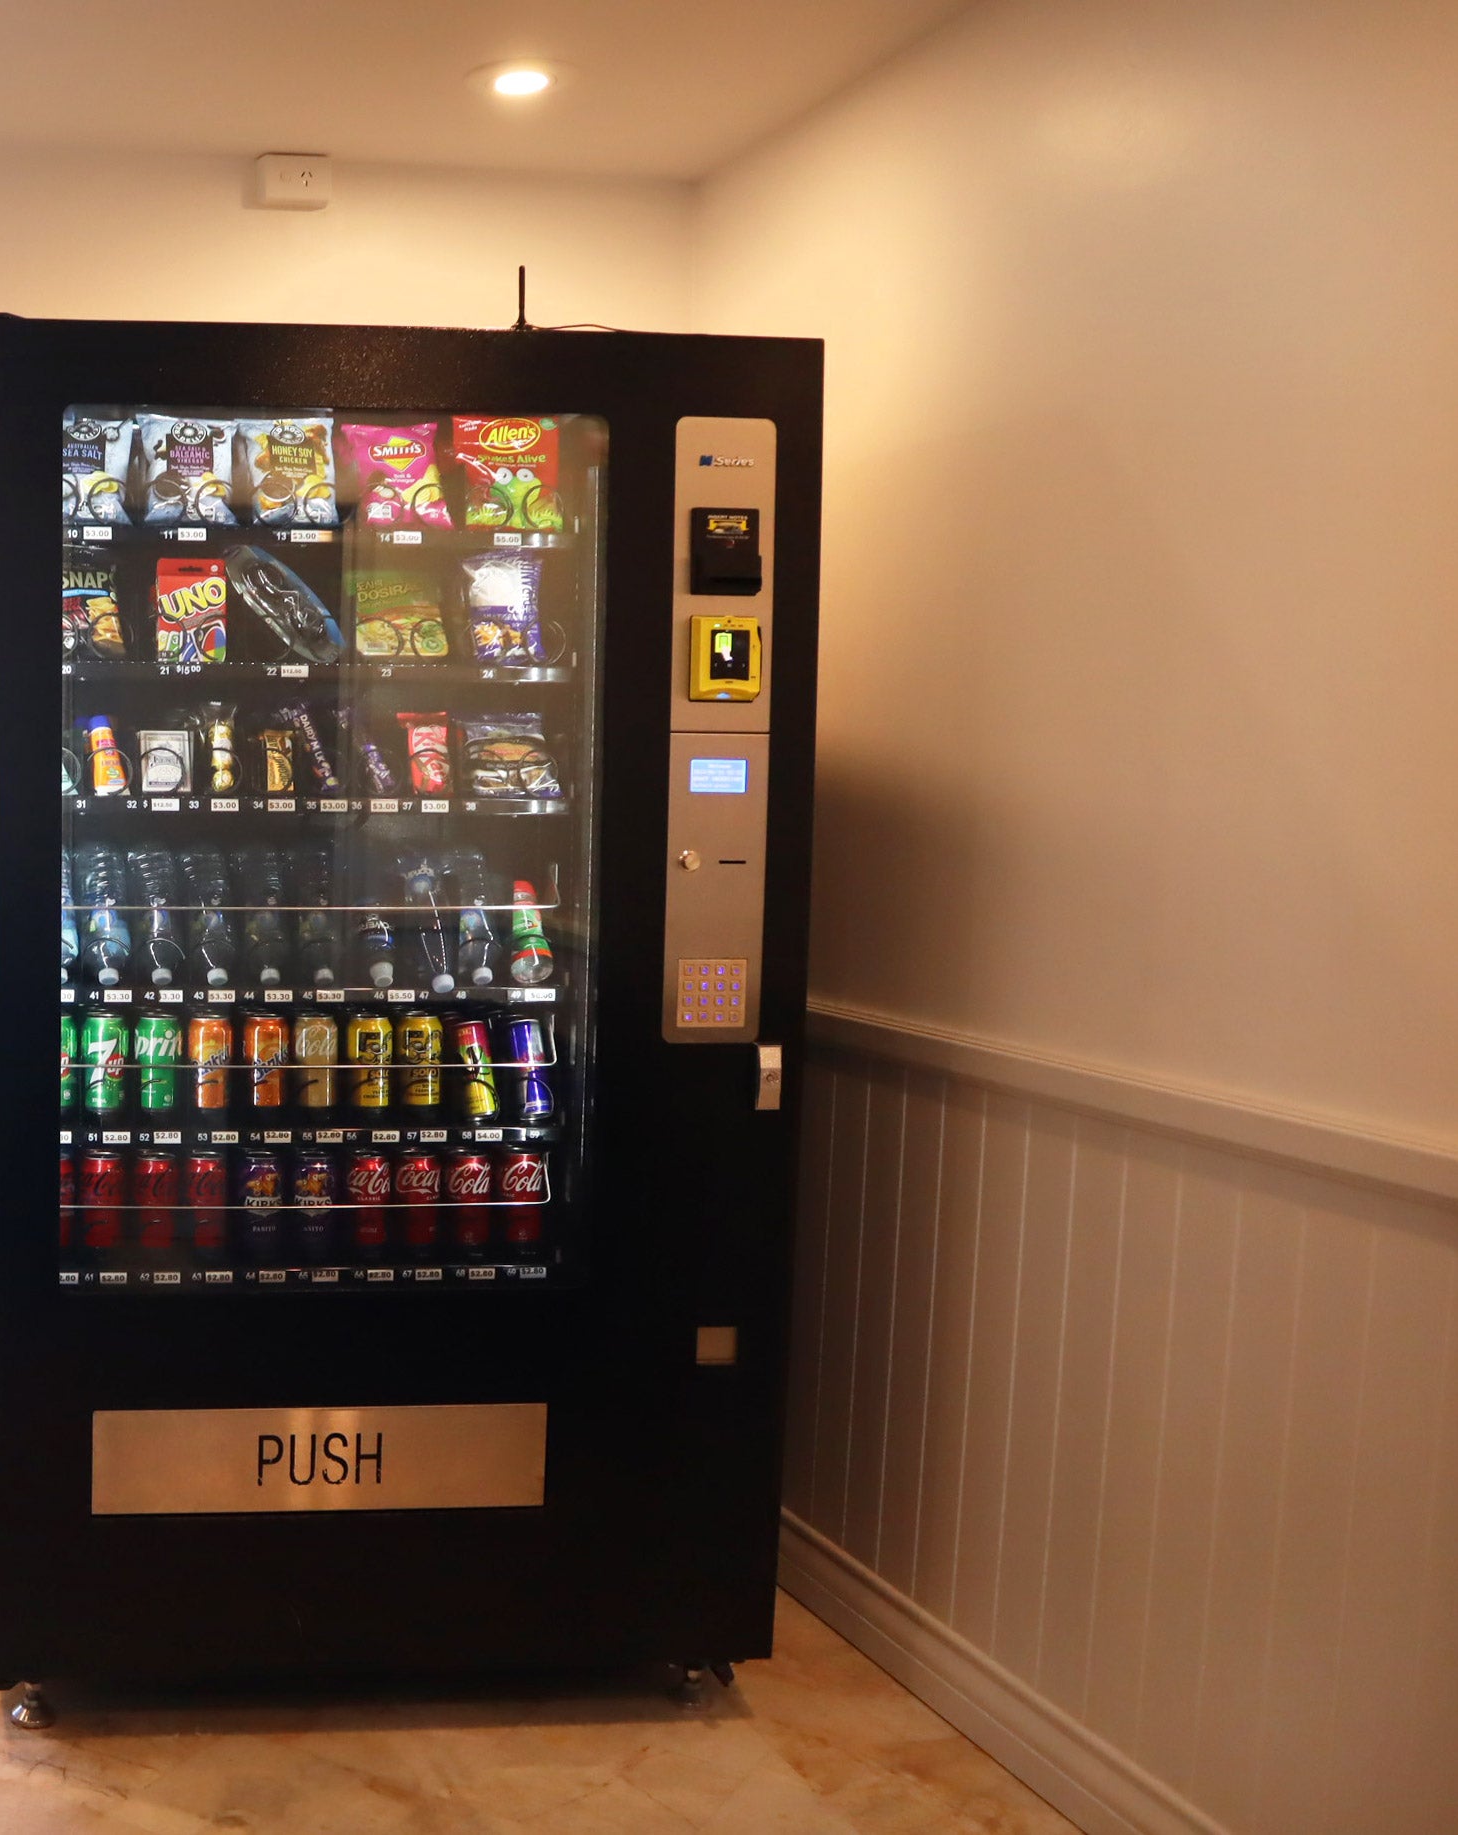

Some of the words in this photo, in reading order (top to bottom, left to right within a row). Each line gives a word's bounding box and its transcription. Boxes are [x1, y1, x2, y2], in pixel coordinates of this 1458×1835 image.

[487, 425, 536, 443] Allen's
[62, 448, 79, 457] SEA
[82, 450, 102, 460] SALT
[170, 450, 210, 459] BALSAMIC
[272, 445, 297, 456] HONEY
[298, 448, 312, 457] SOY
[279, 456, 308, 464] CHICKEN
[713, 456, 755, 466] Series
[67, 529, 78, 538] 10
[163, 530, 173, 540] 11
[276, 532, 287, 541] 13
[292, 532, 317, 540] $3.00
[380, 534, 390, 543] 14
[159, 578, 226, 621] UNO
[160, 666, 170, 675] 21
[266, 667, 277, 676] 22
[381, 668, 392, 677] 23
[482, 669, 494, 679] 24
[76, 800, 86, 809] 31
[126, 801, 138, 809] 32
[188, 801, 200, 809] 33
[252, 801, 264, 809] 34
[306, 801, 317, 809] 35
[351, 801, 362, 809] 36
[402, 802, 413, 810] 37
[466, 802, 477, 811] 38
[89, 991, 99, 1000] 41
[144, 991, 155, 1000] 42
[193, 991, 204, 1000] 43
[243, 991, 255, 1000] 44
[302, 991, 313, 1000] 45
[373, 991, 385, 1000] 46
[389, 992, 412, 1000] $5.50
[419, 991, 430, 1000] 47
[455, 991, 467, 1000] 48
[510, 991, 522, 999] 49
[87, 1038, 118, 1088] 7
[88, 1133, 98, 1142] 51
[139, 1133, 150, 1142] 52
[197, 1133, 208, 1141] 53
[250, 1132, 261, 1141] 54
[302, 1132, 313, 1141] 55
[346, 1132, 357, 1141] 56
[406, 1131, 417, 1140] 57
[461, 1131, 472, 1140] 58
[529, 1130, 540, 1139] 59
[449, 1163, 490, 1194] Cola
[503, 1161, 542, 1191] Cola
[84, 1273, 94, 1281] 61
[101, 1274, 125, 1282] $2.80
[140, 1273, 150, 1281] 62
[192, 1272, 202, 1281] 63
[245, 1272, 256, 1280] 64
[402, 1270, 413, 1278] 67
[470, 1270, 494, 1278] $2.80
[257, 1432, 383, 1486] PUSH
